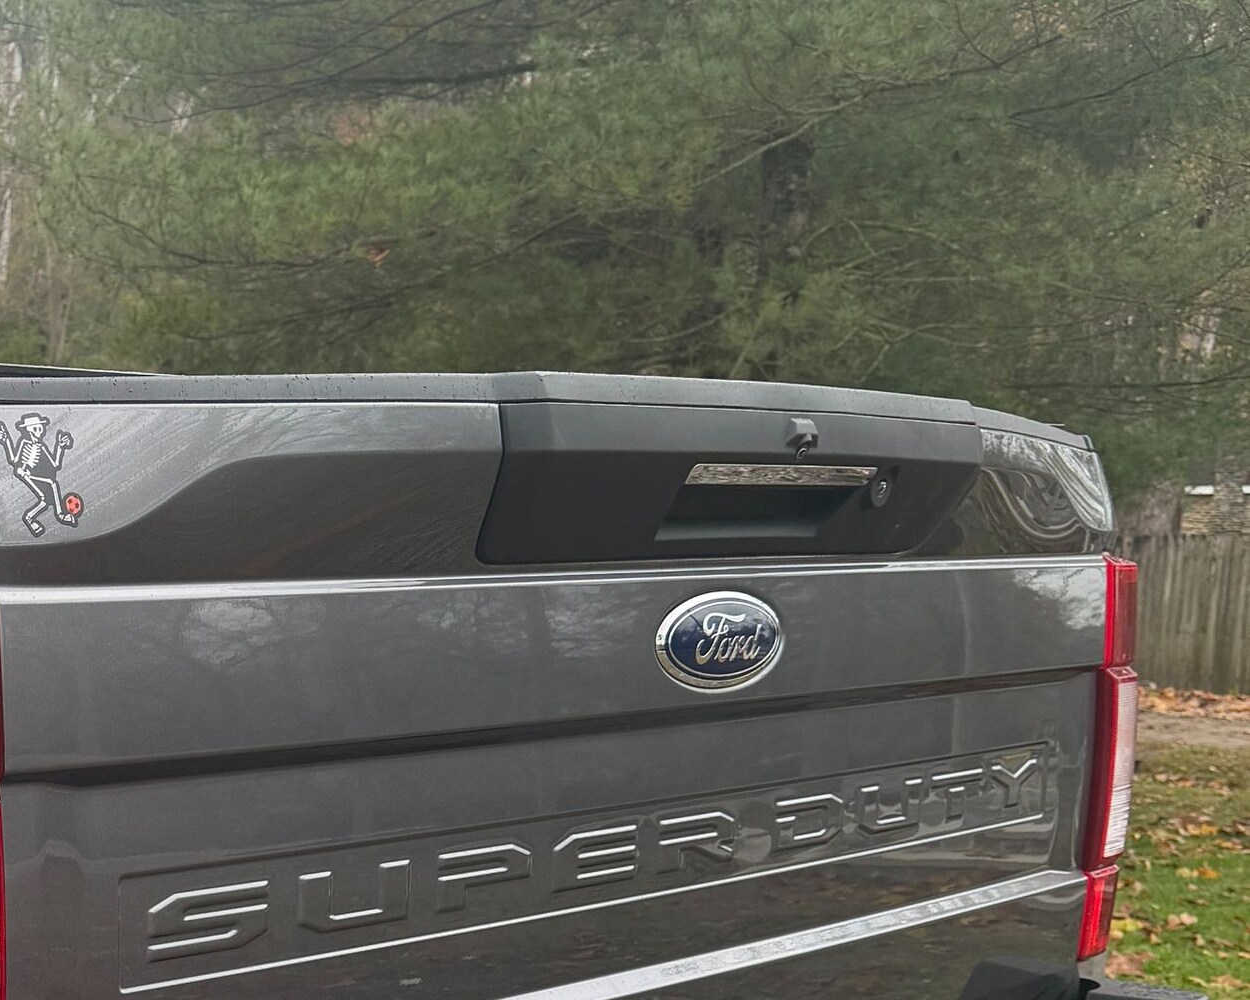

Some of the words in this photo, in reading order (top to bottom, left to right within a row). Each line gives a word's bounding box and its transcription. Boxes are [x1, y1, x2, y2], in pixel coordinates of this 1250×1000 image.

[695, 612, 761, 666] Ford
[146, 808, 740, 962] SUPER
[773, 752, 1039, 853] DUTY
